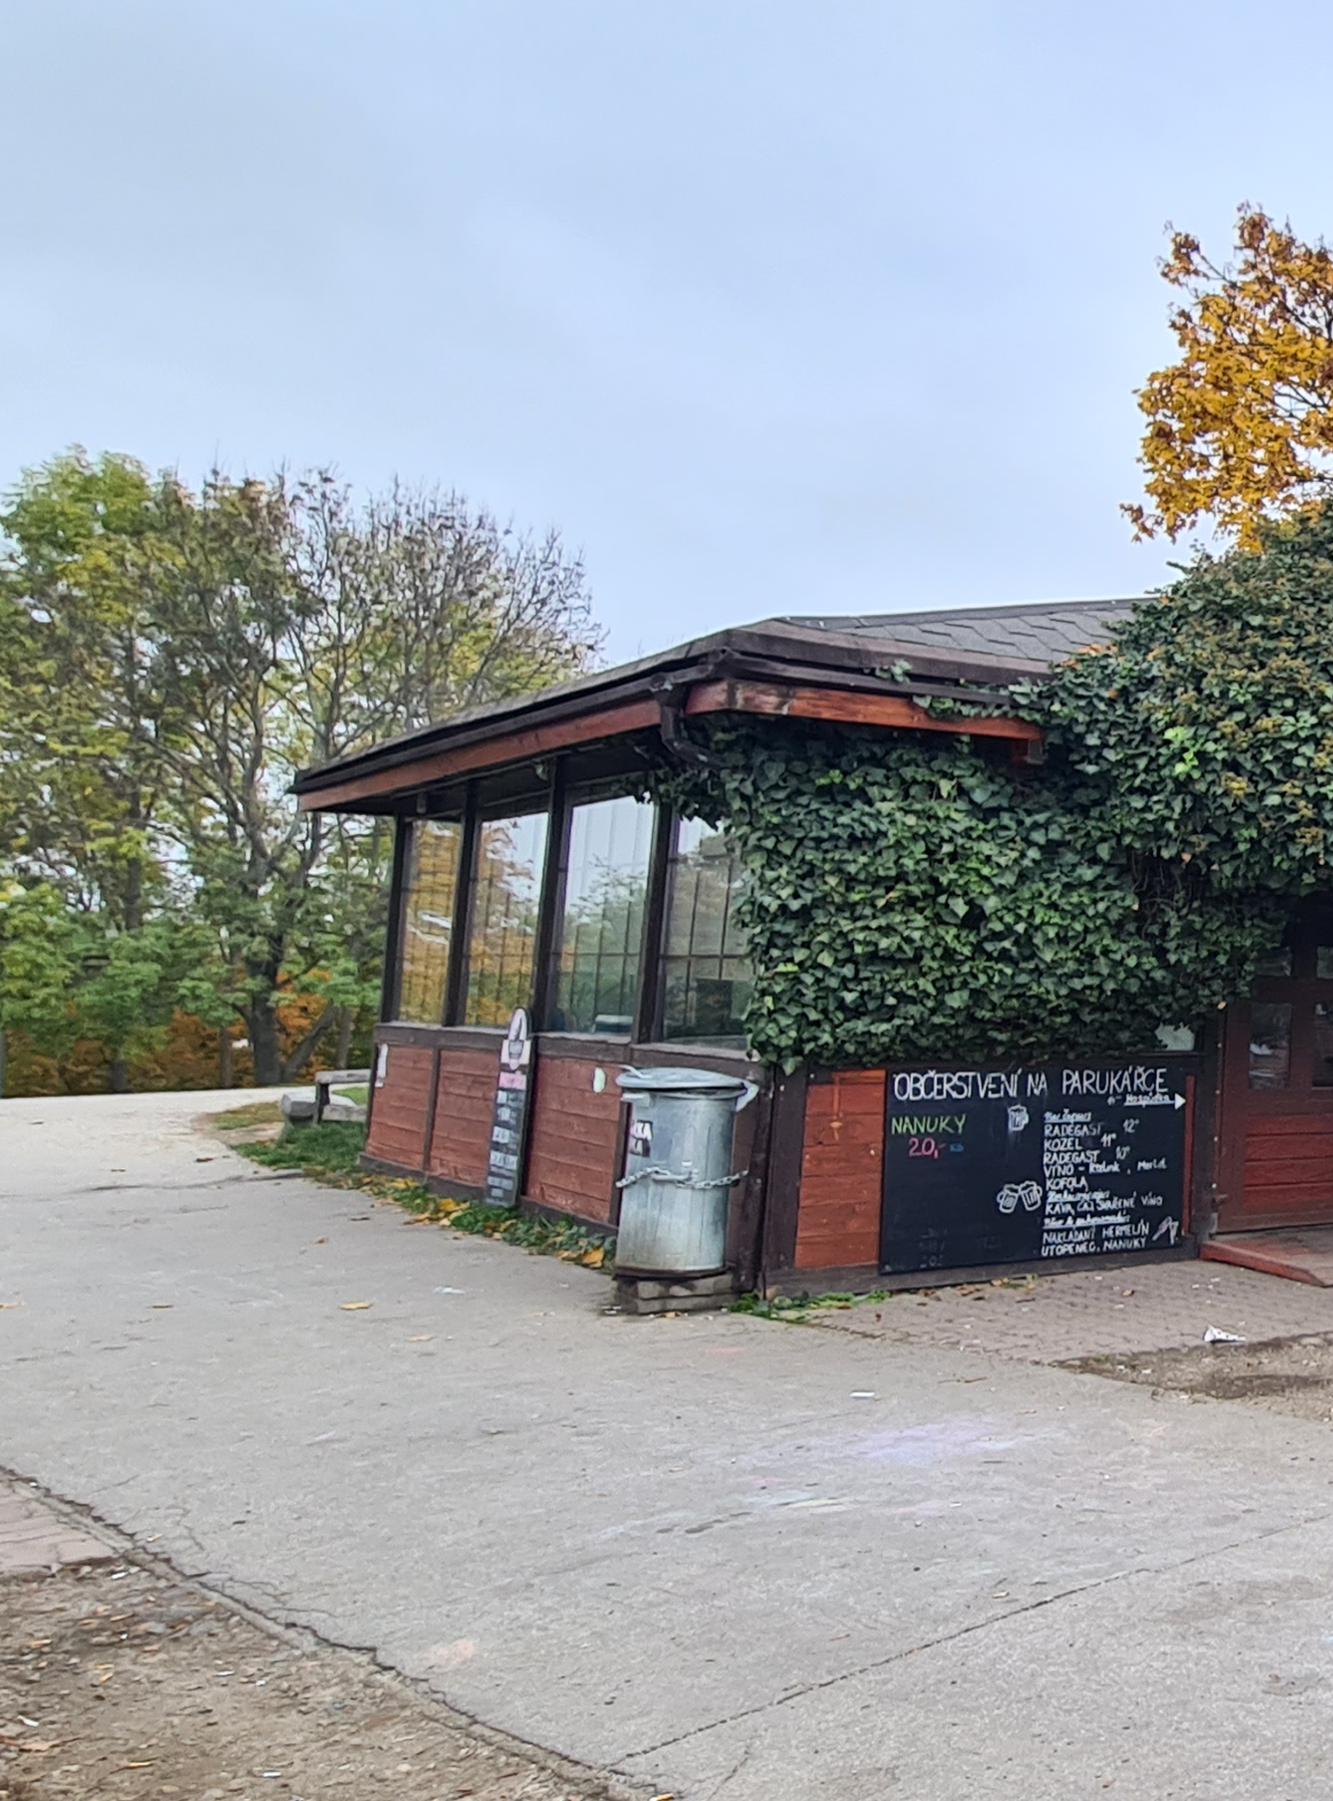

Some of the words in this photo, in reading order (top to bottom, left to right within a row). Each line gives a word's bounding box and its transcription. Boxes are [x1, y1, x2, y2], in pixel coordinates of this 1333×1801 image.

[894, 1068, 1022, 1101] OBČERSTVENÍ
[1027, 1072, 1048, 1096] NA
[1062, 1065, 1168, 1096] PARUKÁŘCE
[891, 1114, 966, 1135] NANUKY
[1043, 1137, 1083, 1152] KOZEL
[1043, 1150, 1100, 1165] RADEGAST
[1045, 1176, 1089, 1192] KOFOLA
